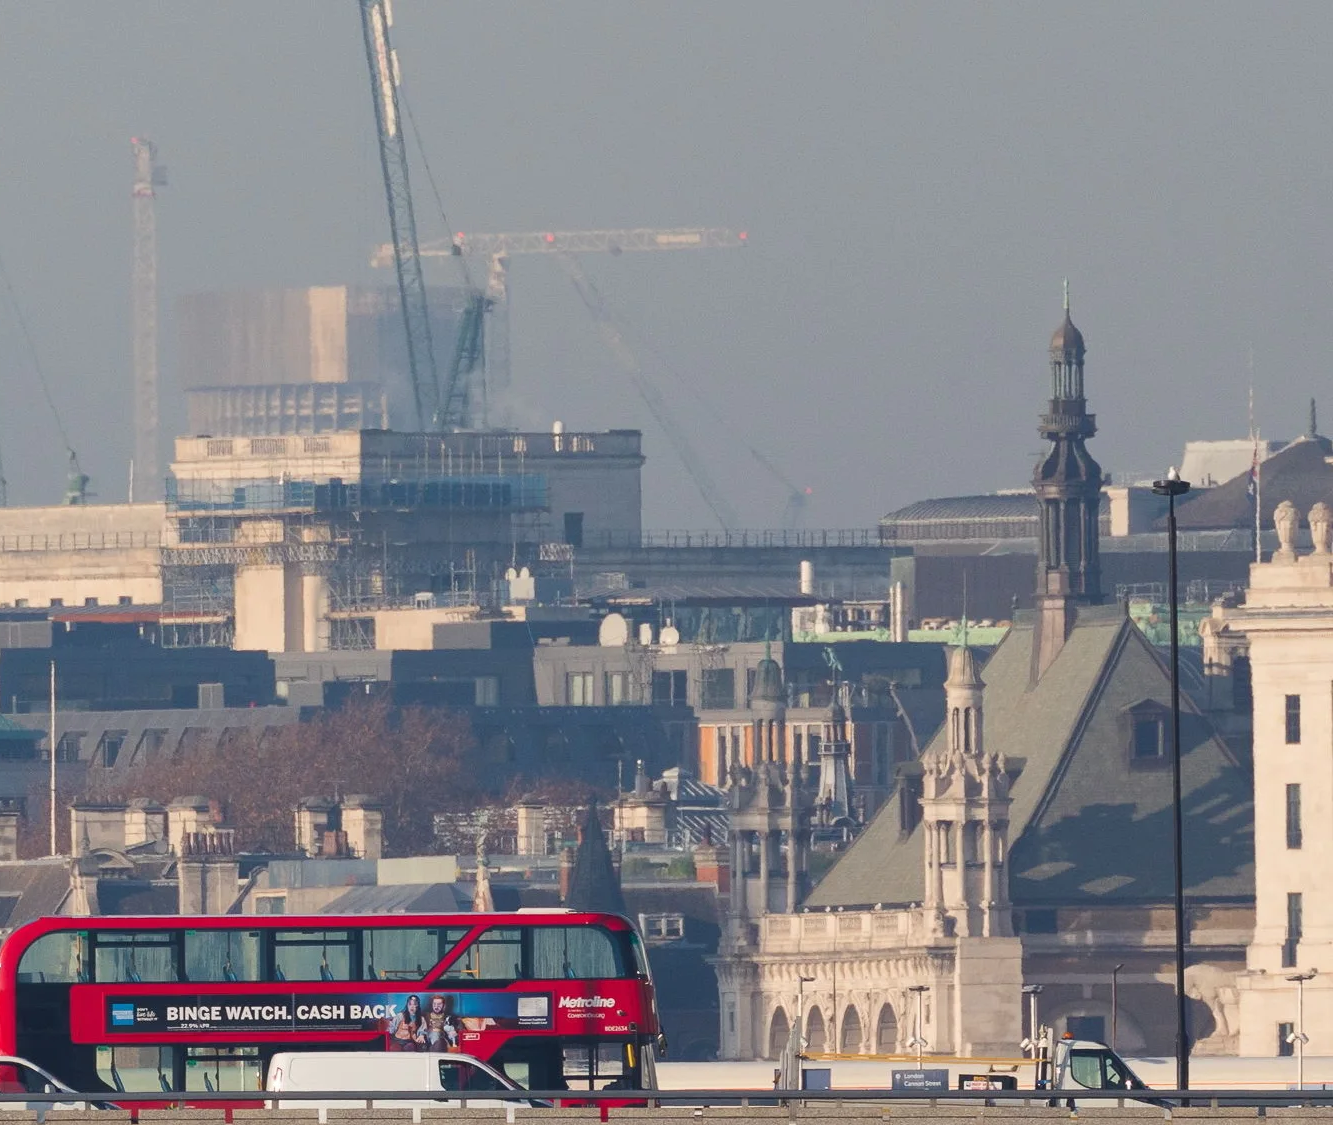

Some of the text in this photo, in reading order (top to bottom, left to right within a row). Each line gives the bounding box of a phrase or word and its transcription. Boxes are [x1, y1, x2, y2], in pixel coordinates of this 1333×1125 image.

[558, 995, 616, 1008] Metroline
[167, 1004, 397, 1021] BINGE WATCH. CASH BACK
